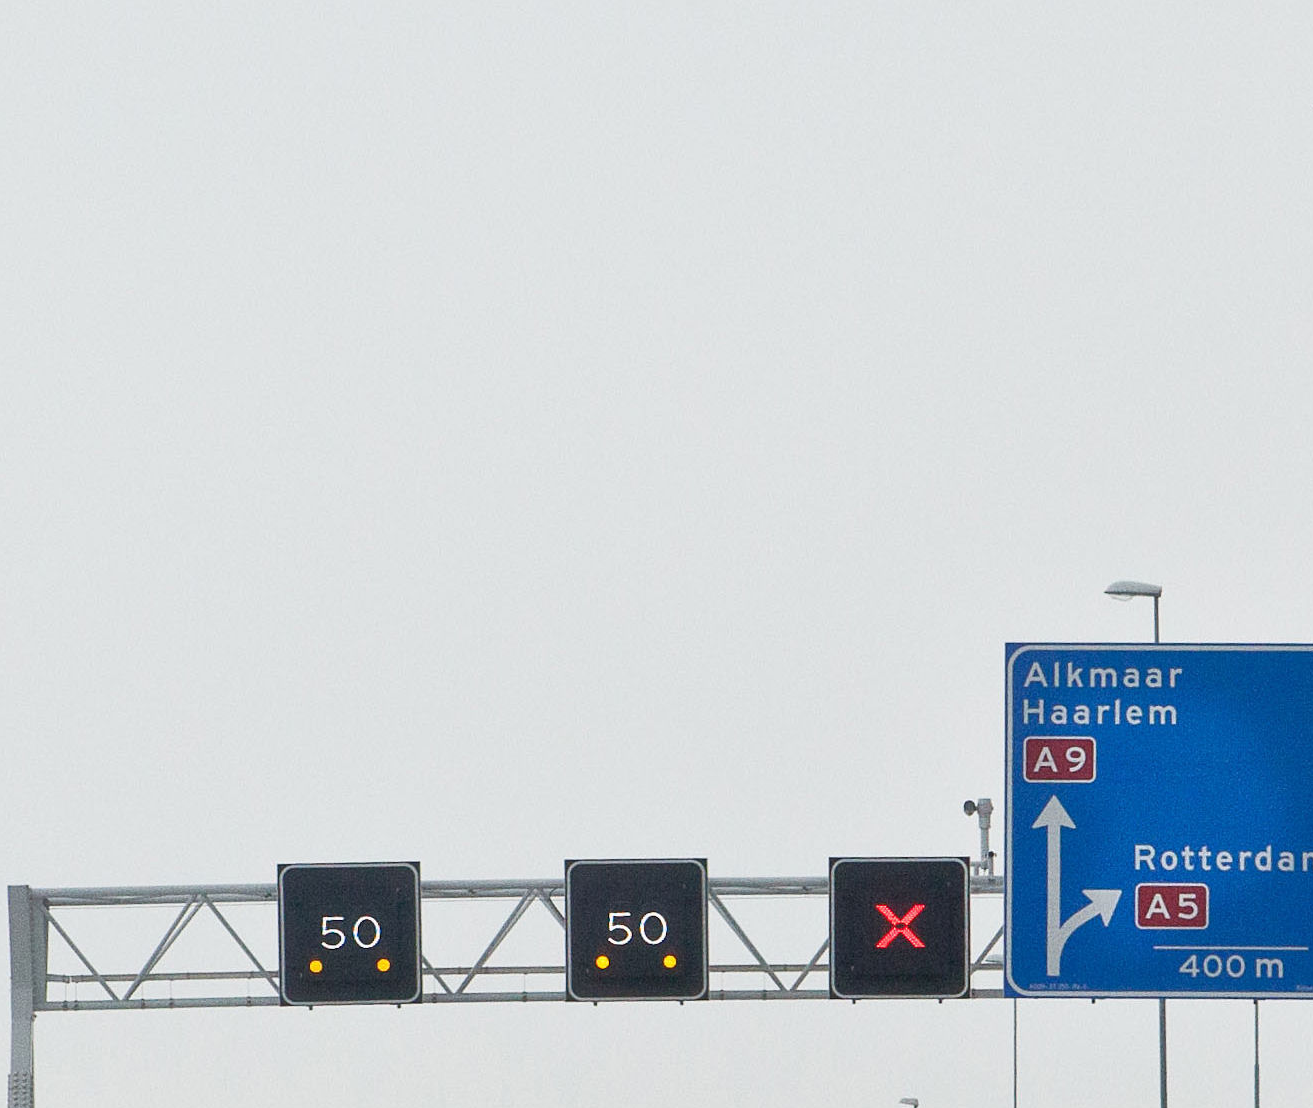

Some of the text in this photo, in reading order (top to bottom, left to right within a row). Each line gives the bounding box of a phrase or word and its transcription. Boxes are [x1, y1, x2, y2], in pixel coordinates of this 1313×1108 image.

[1023, 661, 1183, 688] Alkmaar
[1022, 699, 1178, 726] Haarlem
[1033, 746, 1087, 773] A9
[1145, 893, 1200, 920] A5
[321, 915, 382, 950] 50
[607, 911, 668, 946] 50
[1178, 954, 1285, 978] 400 m
